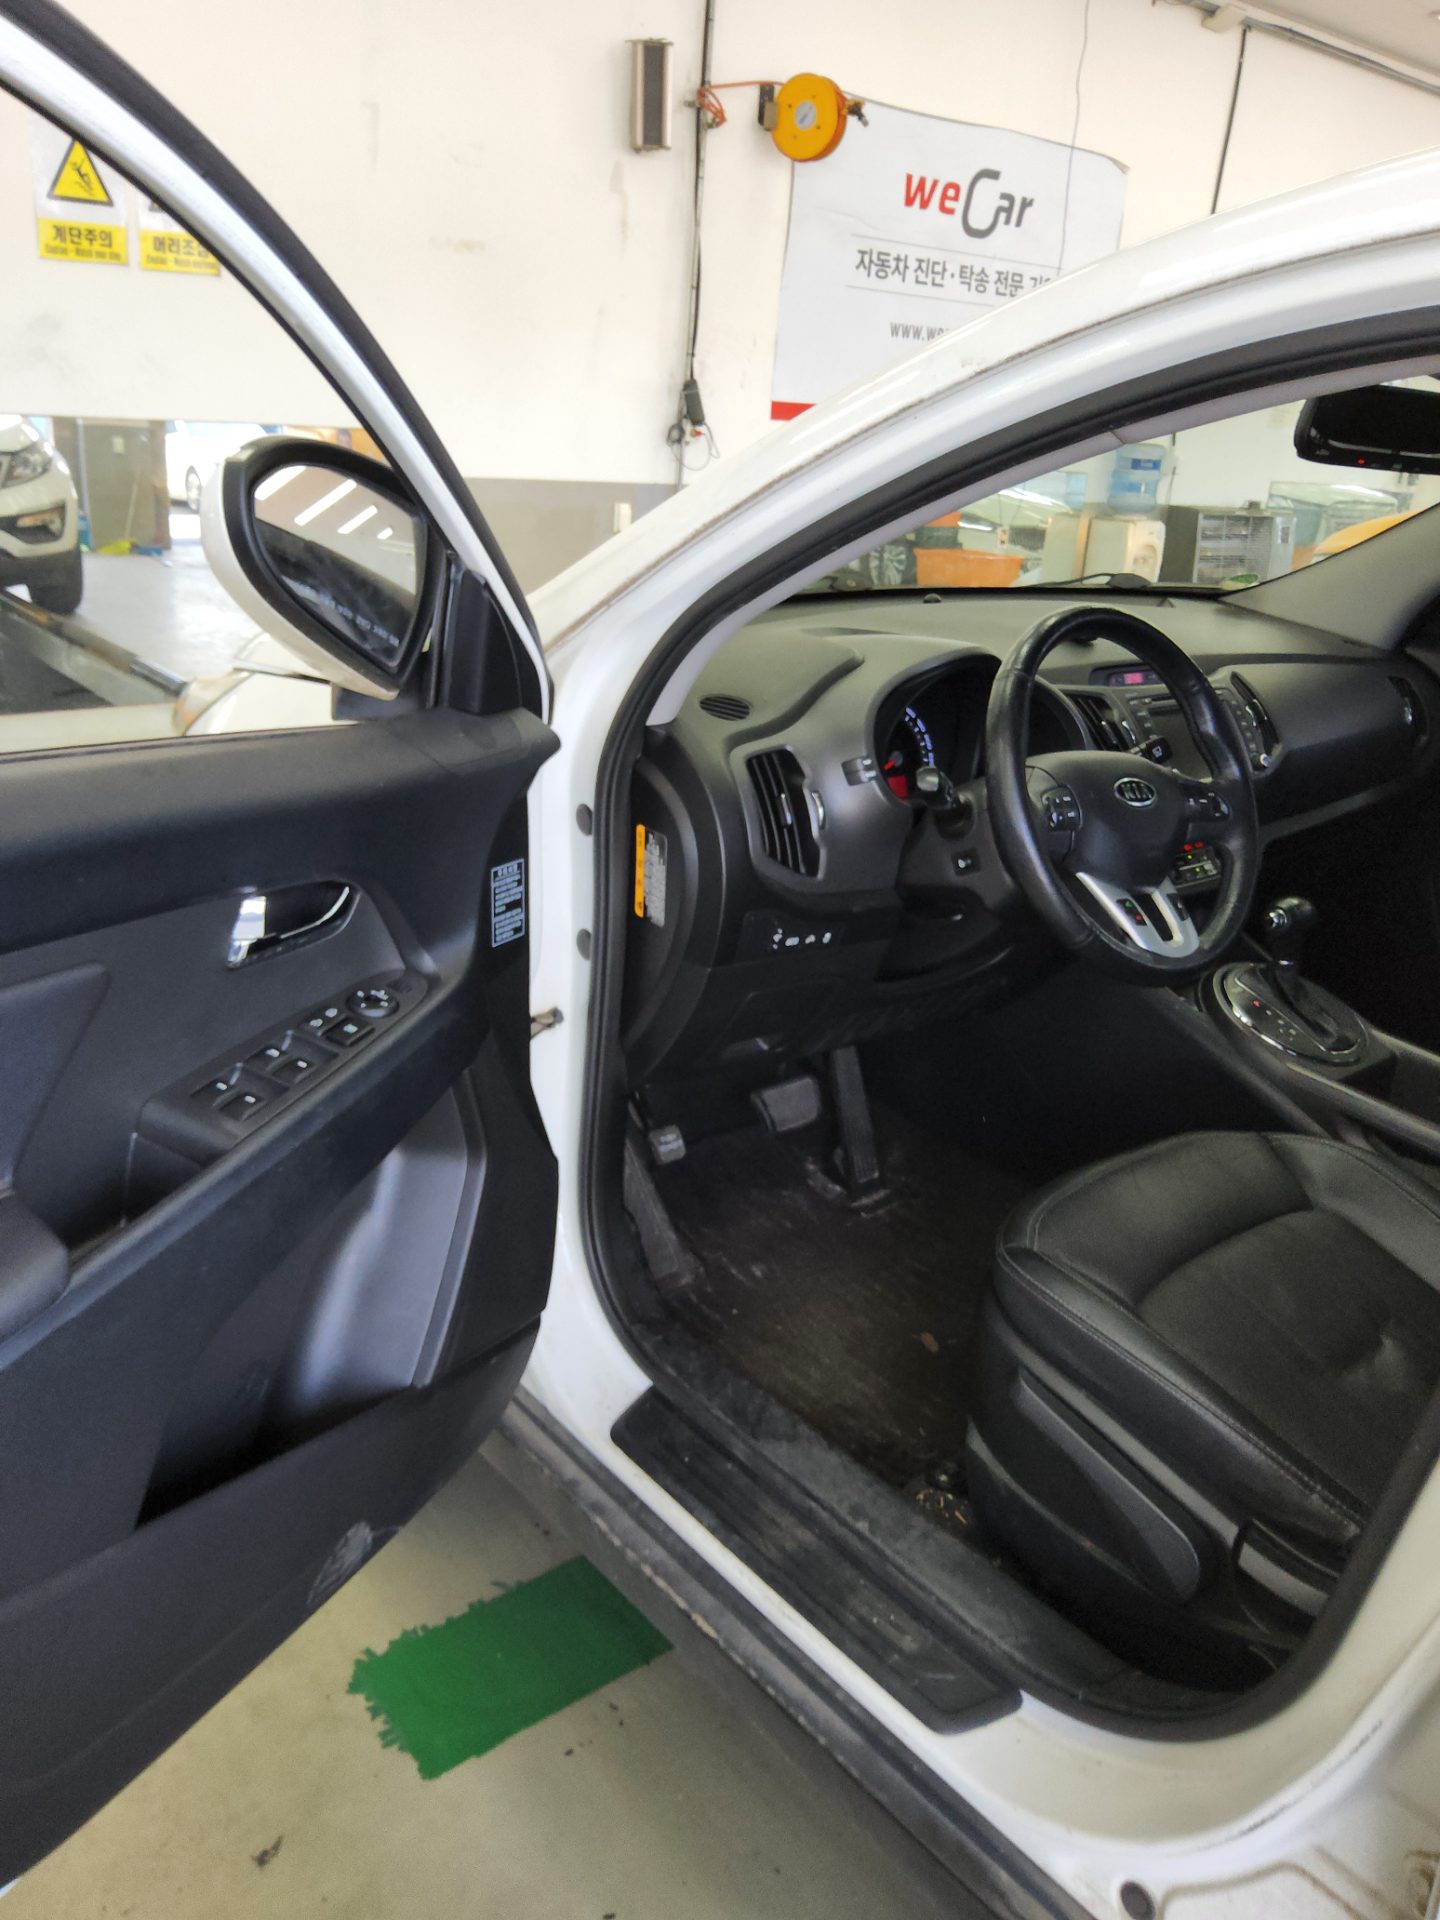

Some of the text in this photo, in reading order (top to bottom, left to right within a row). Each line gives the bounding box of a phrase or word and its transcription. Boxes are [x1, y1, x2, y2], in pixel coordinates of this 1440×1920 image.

[52, 224, 113, 249] 계단주의
[855, 248, 909, 283] 자동차
[994, 270, 1024, 298] 전문
[1029, 274, 1052, 289] 기
